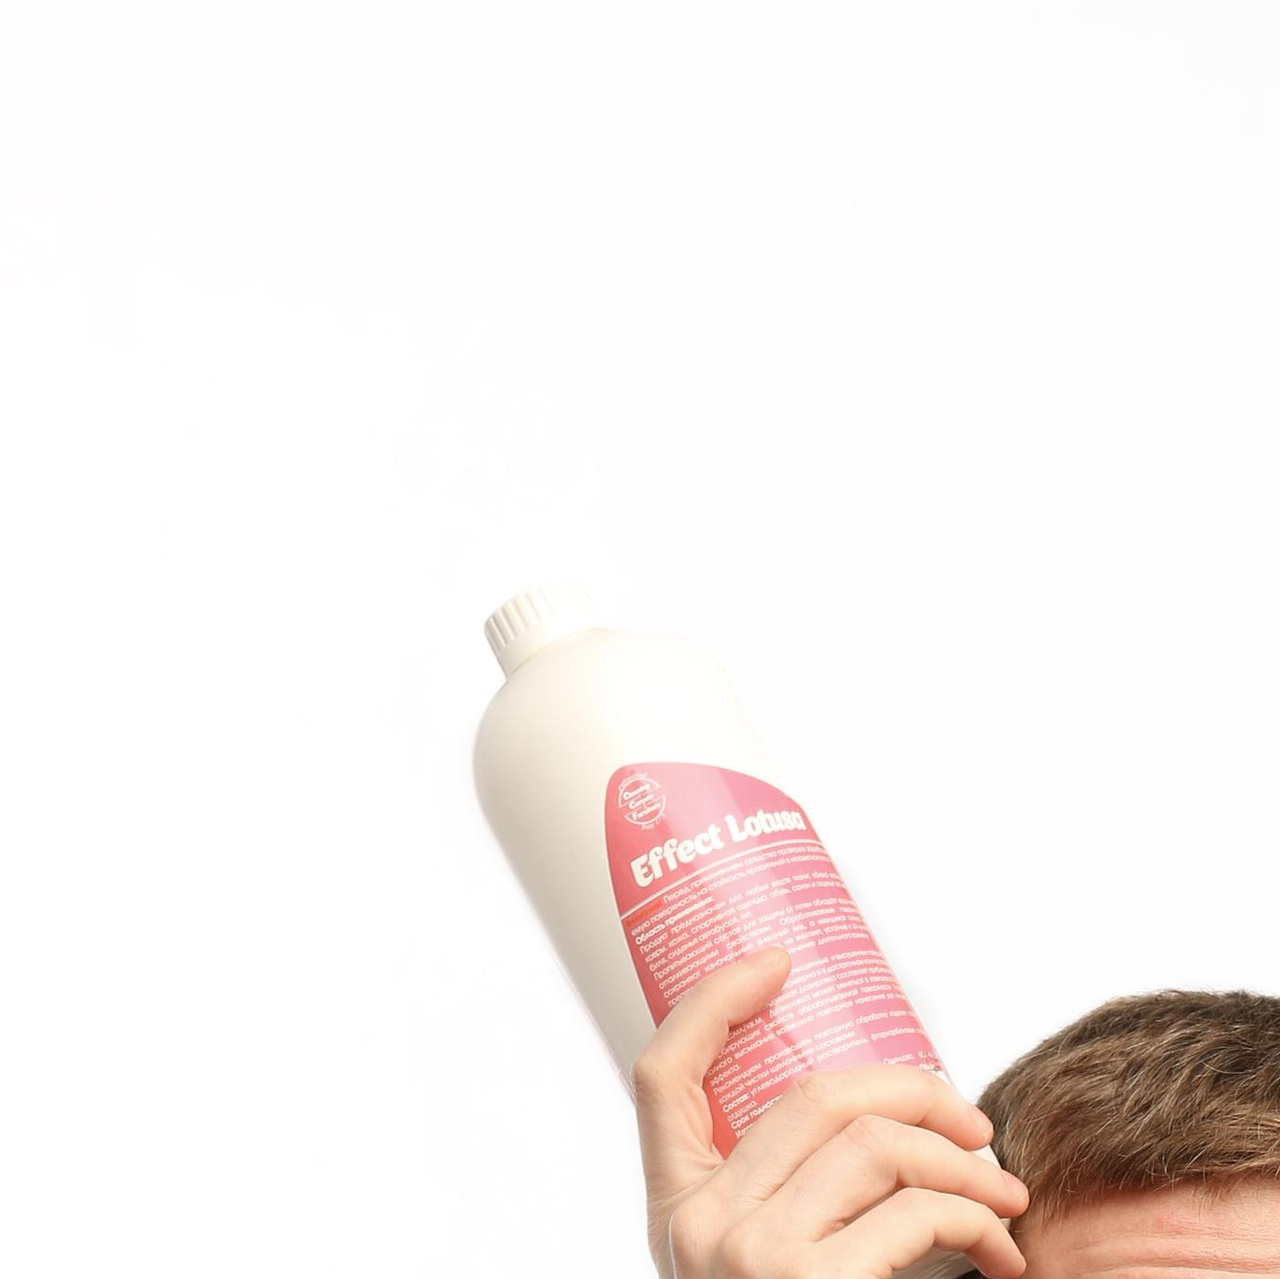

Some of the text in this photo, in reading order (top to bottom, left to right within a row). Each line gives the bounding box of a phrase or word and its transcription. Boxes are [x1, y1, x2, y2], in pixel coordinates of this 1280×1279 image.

[629, 808, 807, 888] Effect Lotusa
[651, 894, 696, 922] поверхность
[690, 907, 734, 933] спортивная
[635, 923, 664, 943] Область
[640, 932, 668, 952] Продукт
[671, 901, 724, 933] предназначен
[729, 893, 741, 903] для
[713, 926, 741, 942] состав
[743, 920, 756, 929] для
[659, 949, 719, 988] отталкивающими
[714, 1062, 761, 1093] Рекомендуем
[722, 1091, 750, 1111] Состав:
[730, 1114, 749, 1129] Срок
